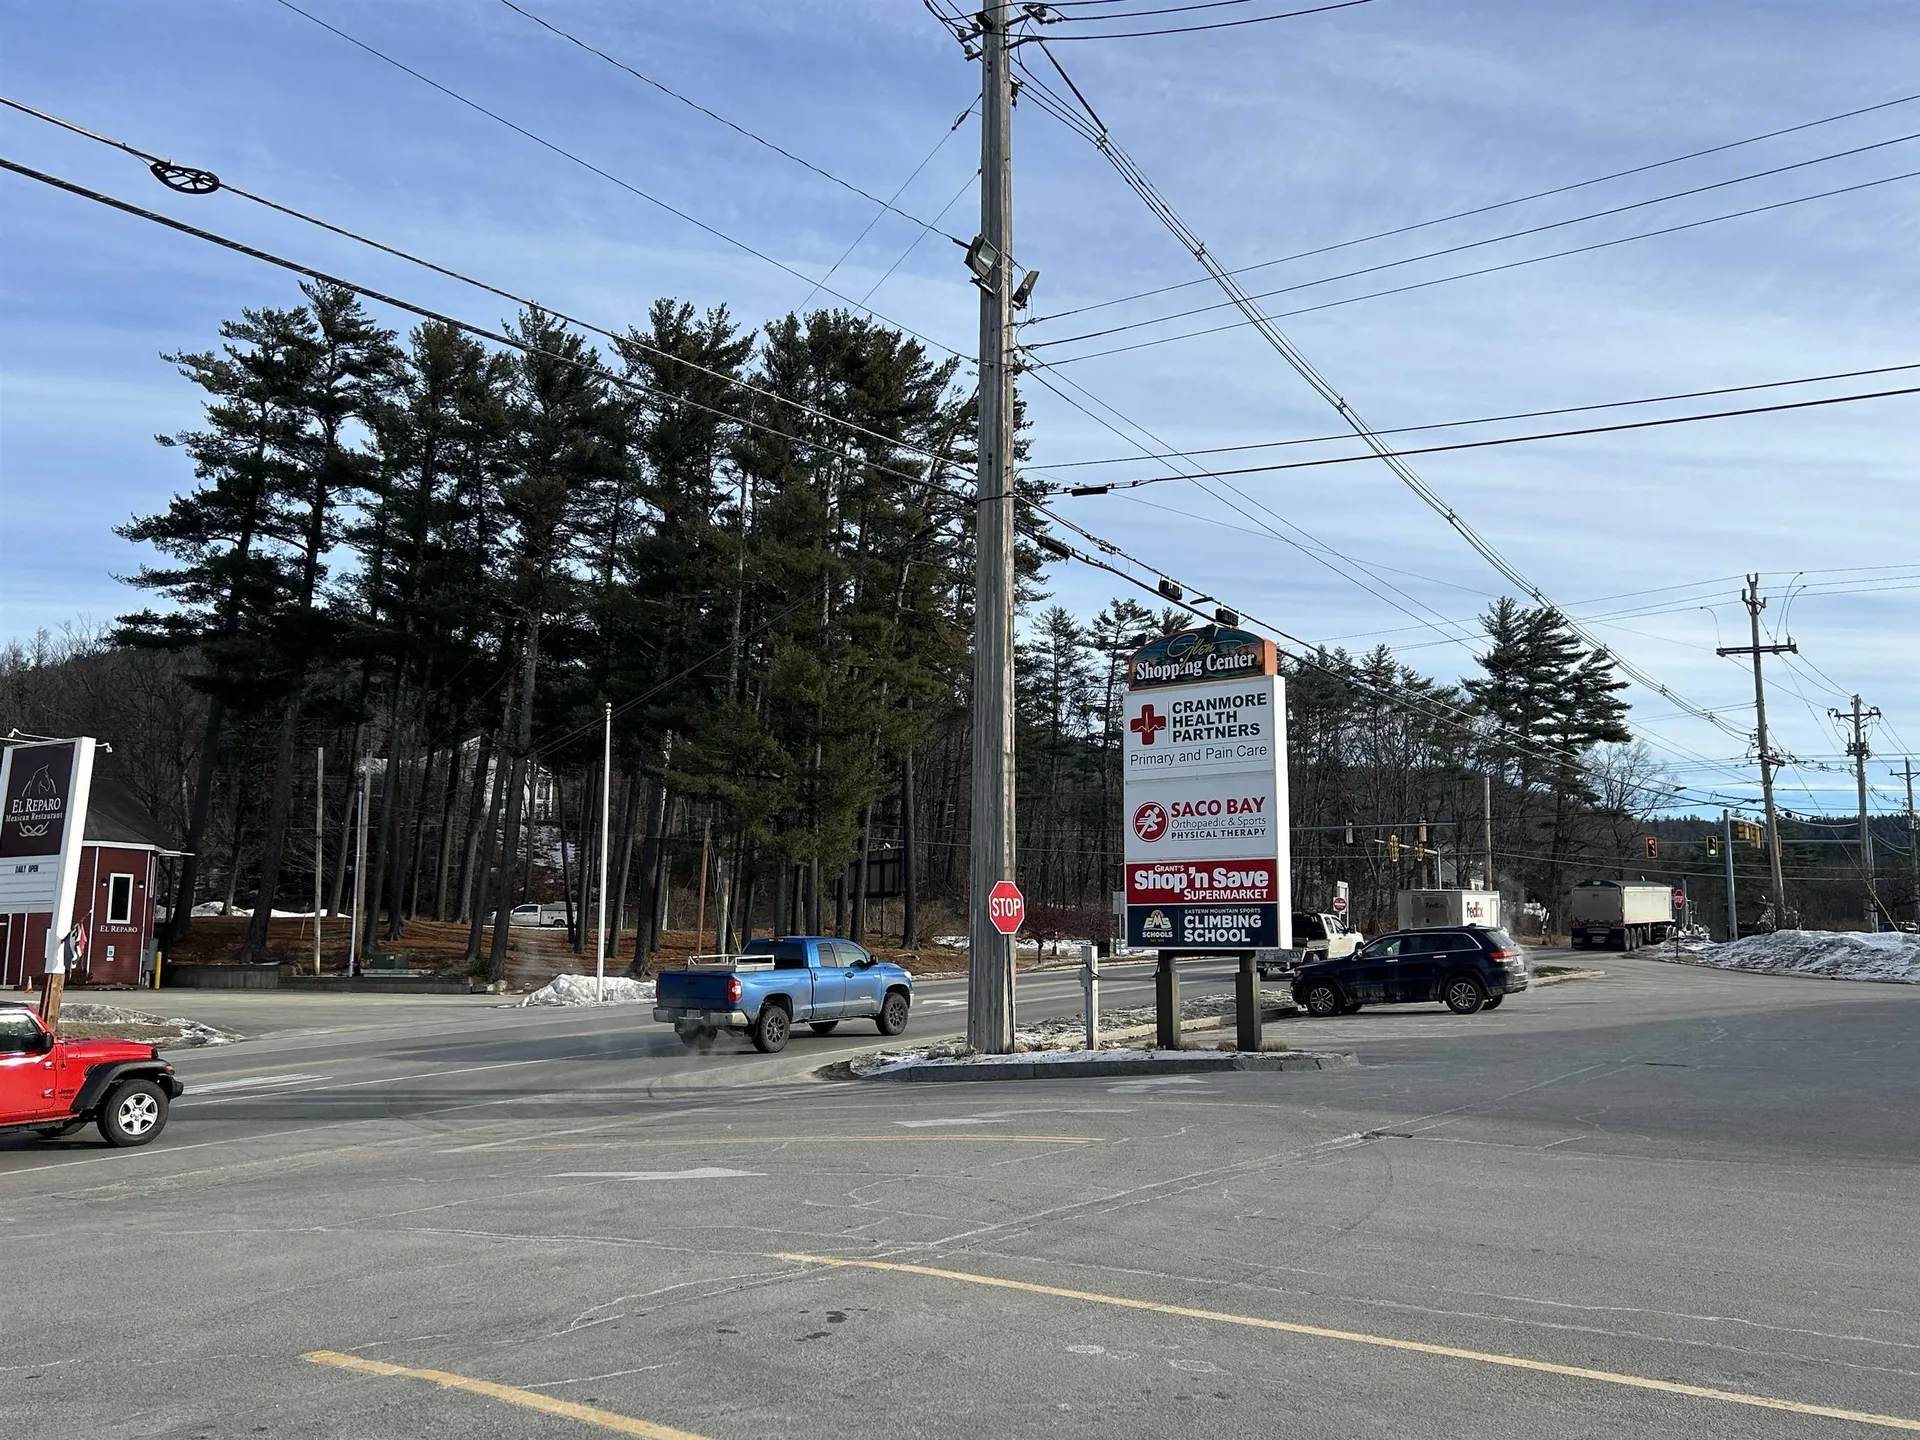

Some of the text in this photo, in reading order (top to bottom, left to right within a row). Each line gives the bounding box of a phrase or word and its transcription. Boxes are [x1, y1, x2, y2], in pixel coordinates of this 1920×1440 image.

[1136, 652, 1255, 680] Shopping Center
[1172, 693, 1267, 714] CRANMORE
[1172, 711, 1237, 728] HEALTH
[1173, 723, 1260, 743] PARTNERS
[1130, 745, 1267, 766] Primary and Pain Care
[11, 798, 61, 813] EL REPARO
[1171, 796, 1266, 818] SACO BAY
[5, 812, 63, 822] Mexican Restaurant
[1171, 816, 1266, 830] Orthopaedic & Sports
[1171, 828, 1266, 839] PHYSICAL THERAPY
[1134, 870, 1187, 893] Shop
[1213, 868, 1269, 888] Save
[1184, 888, 1268, 900] SUPERMARKET
[992, 897, 1021, 917] STOP
[1466, 901, 1484, 918] FedEx
[111, 925, 138, 933] REPARO
[1143, 915, 1172, 929] EMS
[1184, 915, 1261, 928] CLIMBING
[1184, 929, 1251, 942] SCHOOL
